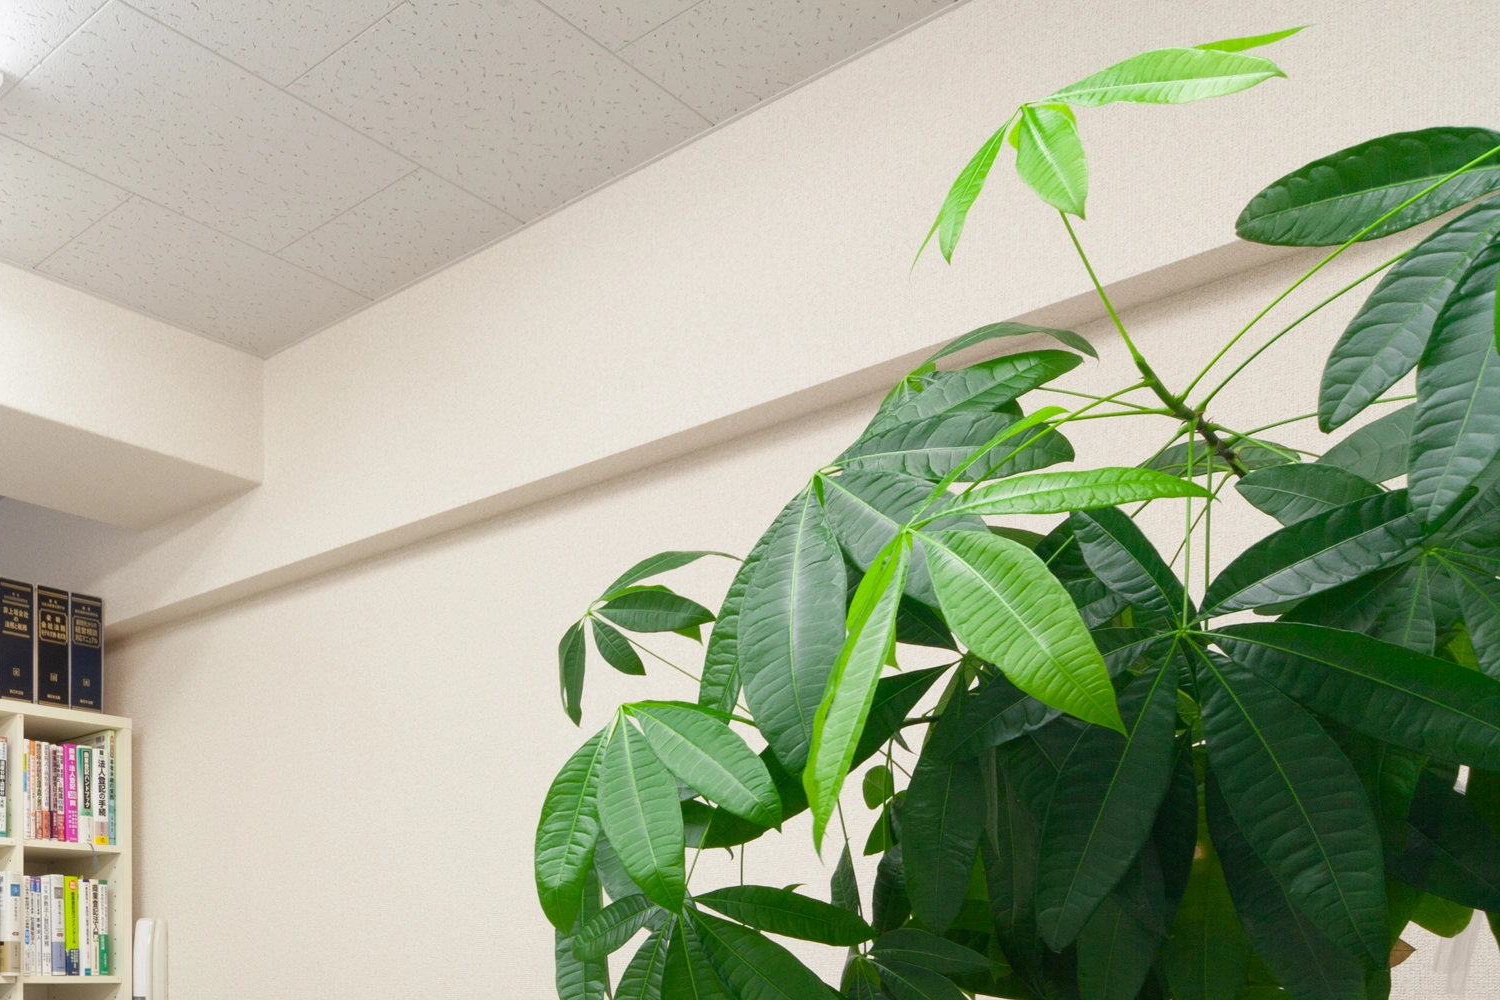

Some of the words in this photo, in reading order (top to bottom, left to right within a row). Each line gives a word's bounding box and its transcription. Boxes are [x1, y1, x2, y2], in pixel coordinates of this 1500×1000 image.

[3, 606, 29, 619] 非上場会社
[98, 759, 106, 817] 法人登記の手続
